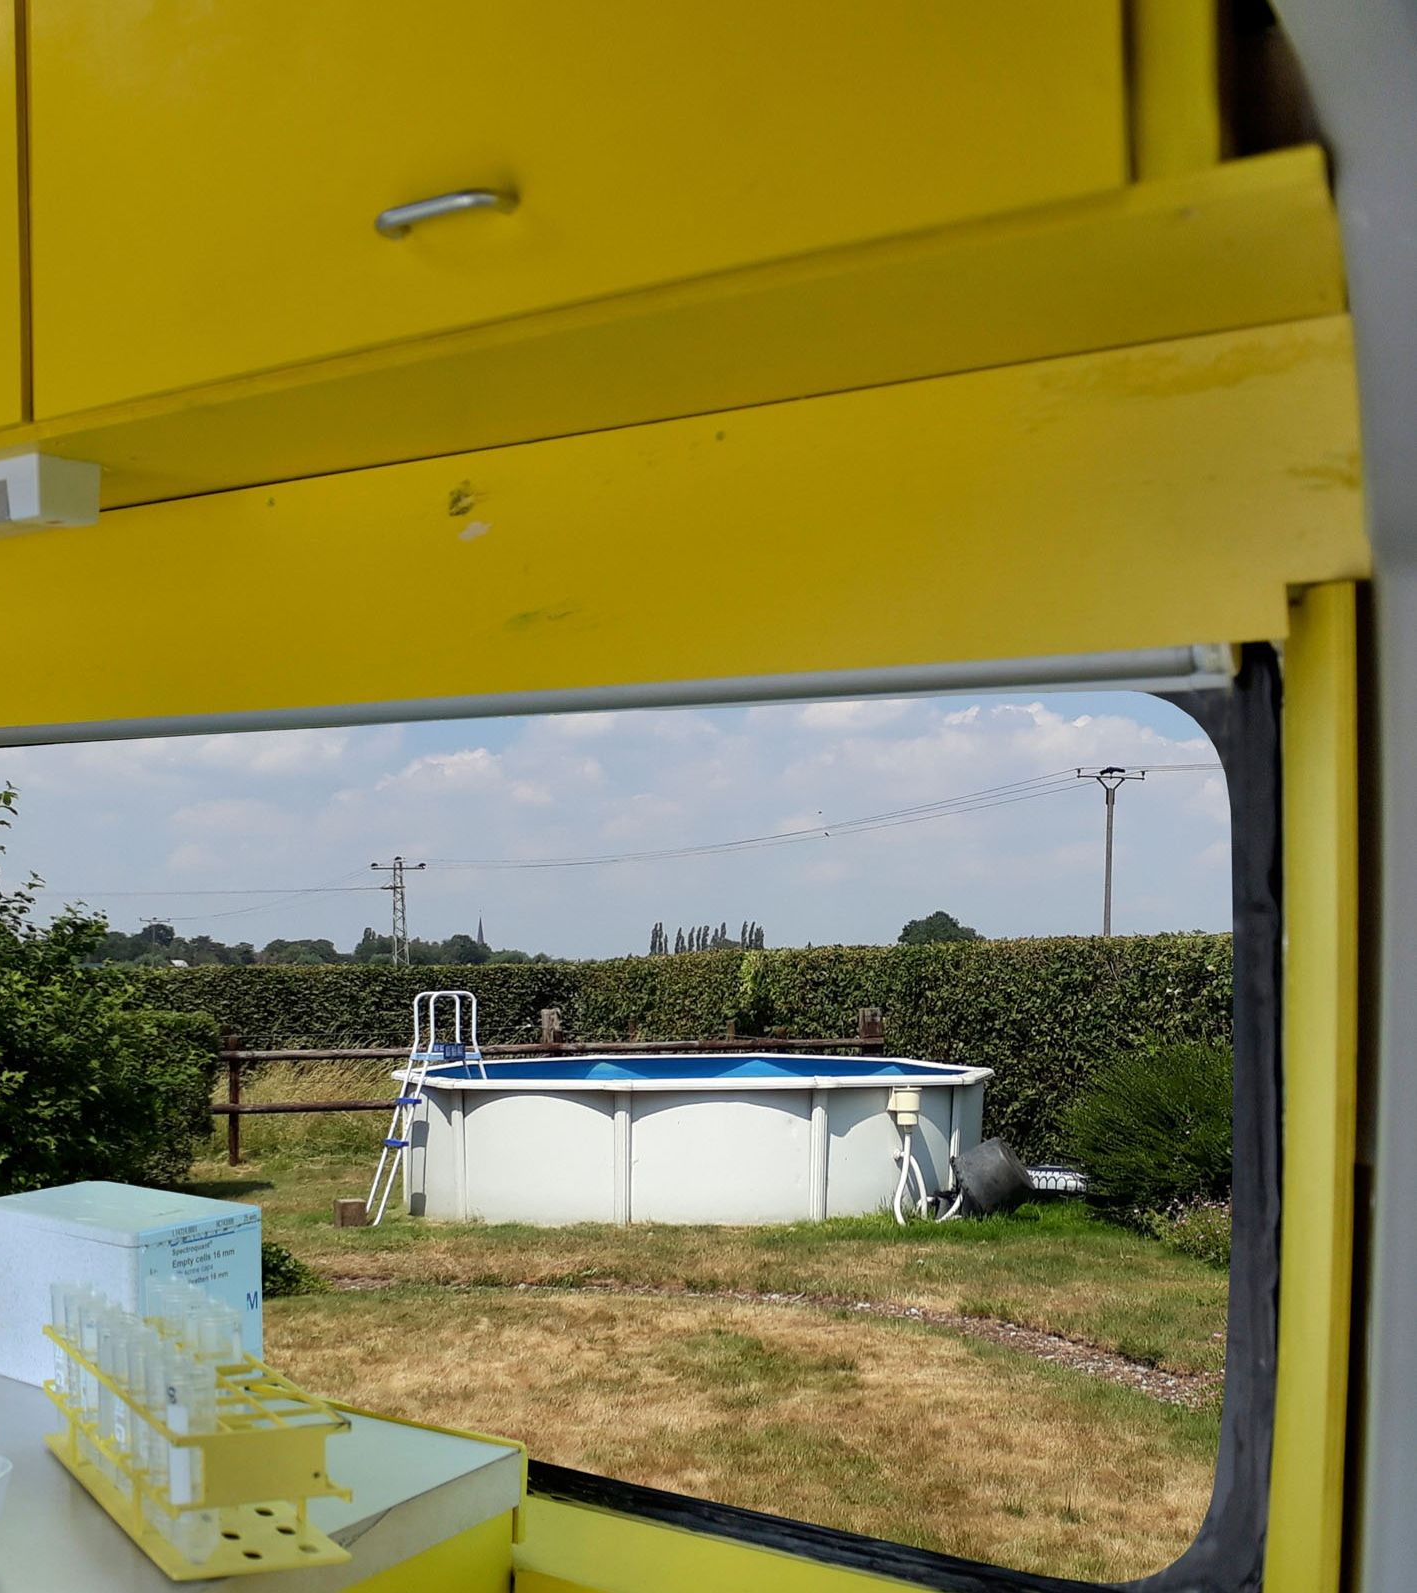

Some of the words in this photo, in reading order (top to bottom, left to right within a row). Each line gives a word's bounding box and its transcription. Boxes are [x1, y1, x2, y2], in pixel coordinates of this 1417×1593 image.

[172, 1257, 194, 1268] Empty
[196, 1253, 211, 1263] cells
[213, 1251, 221, 1259] 16
[222, 1249, 235, 1257] mm
[246, 1291, 258, 1310] M
